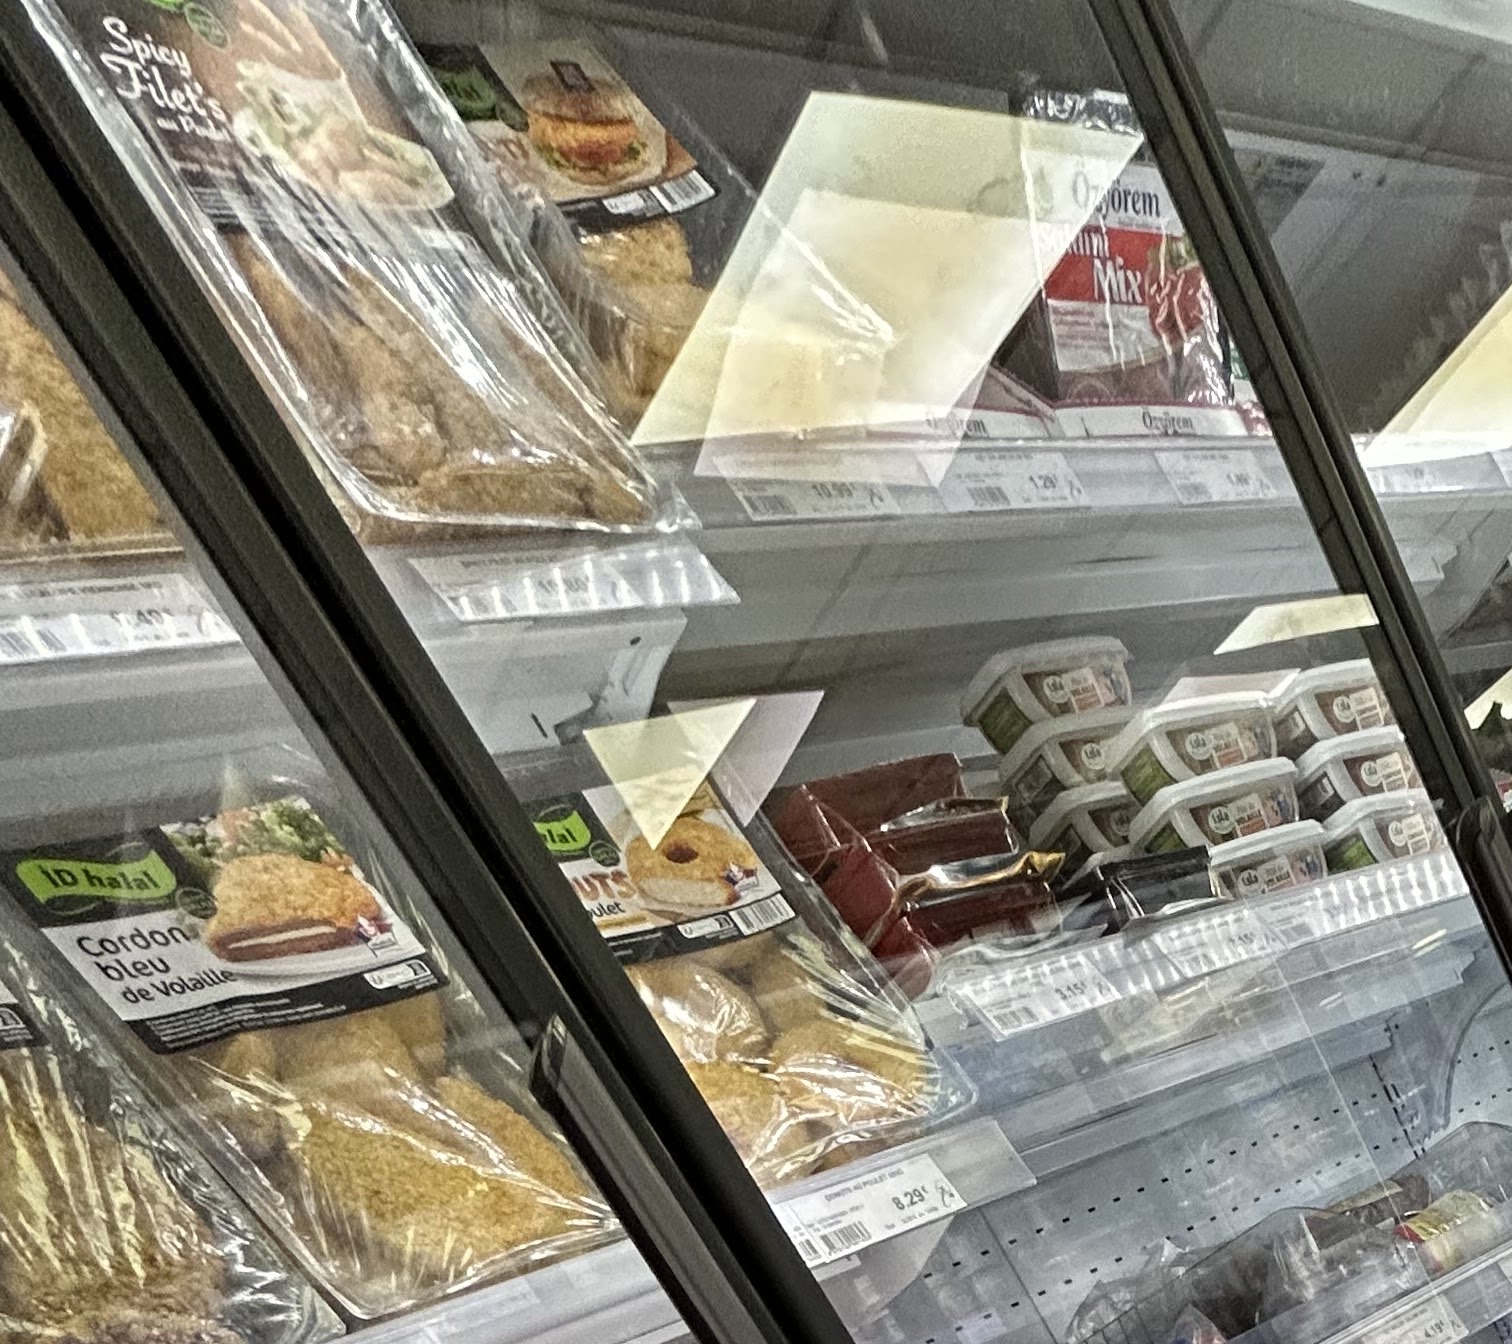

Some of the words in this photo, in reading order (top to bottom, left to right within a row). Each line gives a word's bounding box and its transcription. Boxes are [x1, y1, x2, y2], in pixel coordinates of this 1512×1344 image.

[102, 15, 192, 78] Spicy
[1093, 255, 1143, 303] Mix
[87, 863, 160, 894] halal
[77, 924, 190, 958] Cordon
[94, 957, 171, 984] bleu
[121, 985, 154, 1005] de
[154, 968, 237, 1001] Volaille
